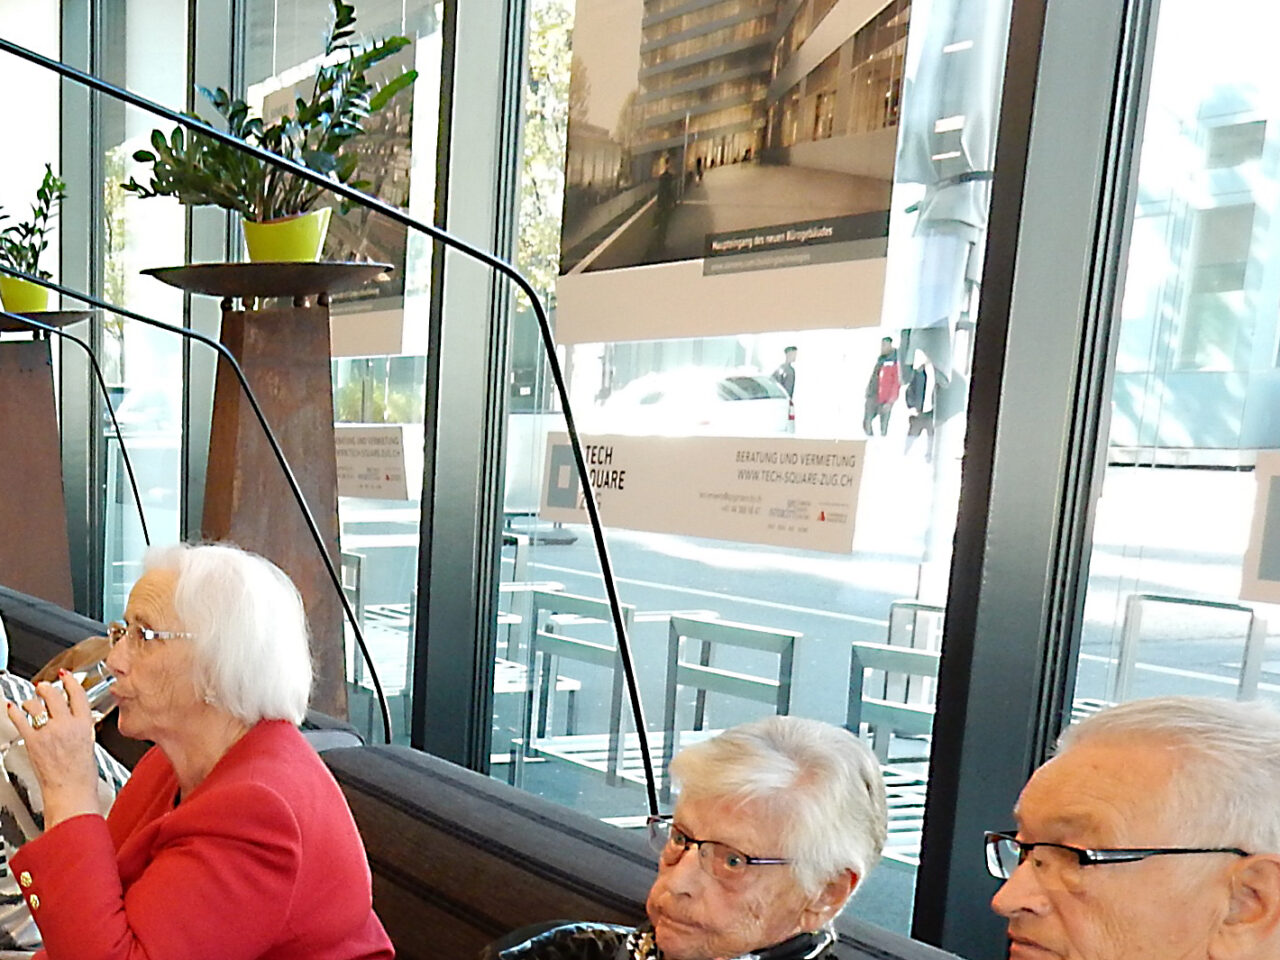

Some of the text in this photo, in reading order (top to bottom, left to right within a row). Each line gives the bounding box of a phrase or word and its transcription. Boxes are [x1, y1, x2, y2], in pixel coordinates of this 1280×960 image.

[585, 445, 613, 465] TECH
[736, 451, 856, 468] BERATUNG UND VERMIETUNG
[585, 469, 626, 490] QUARE
